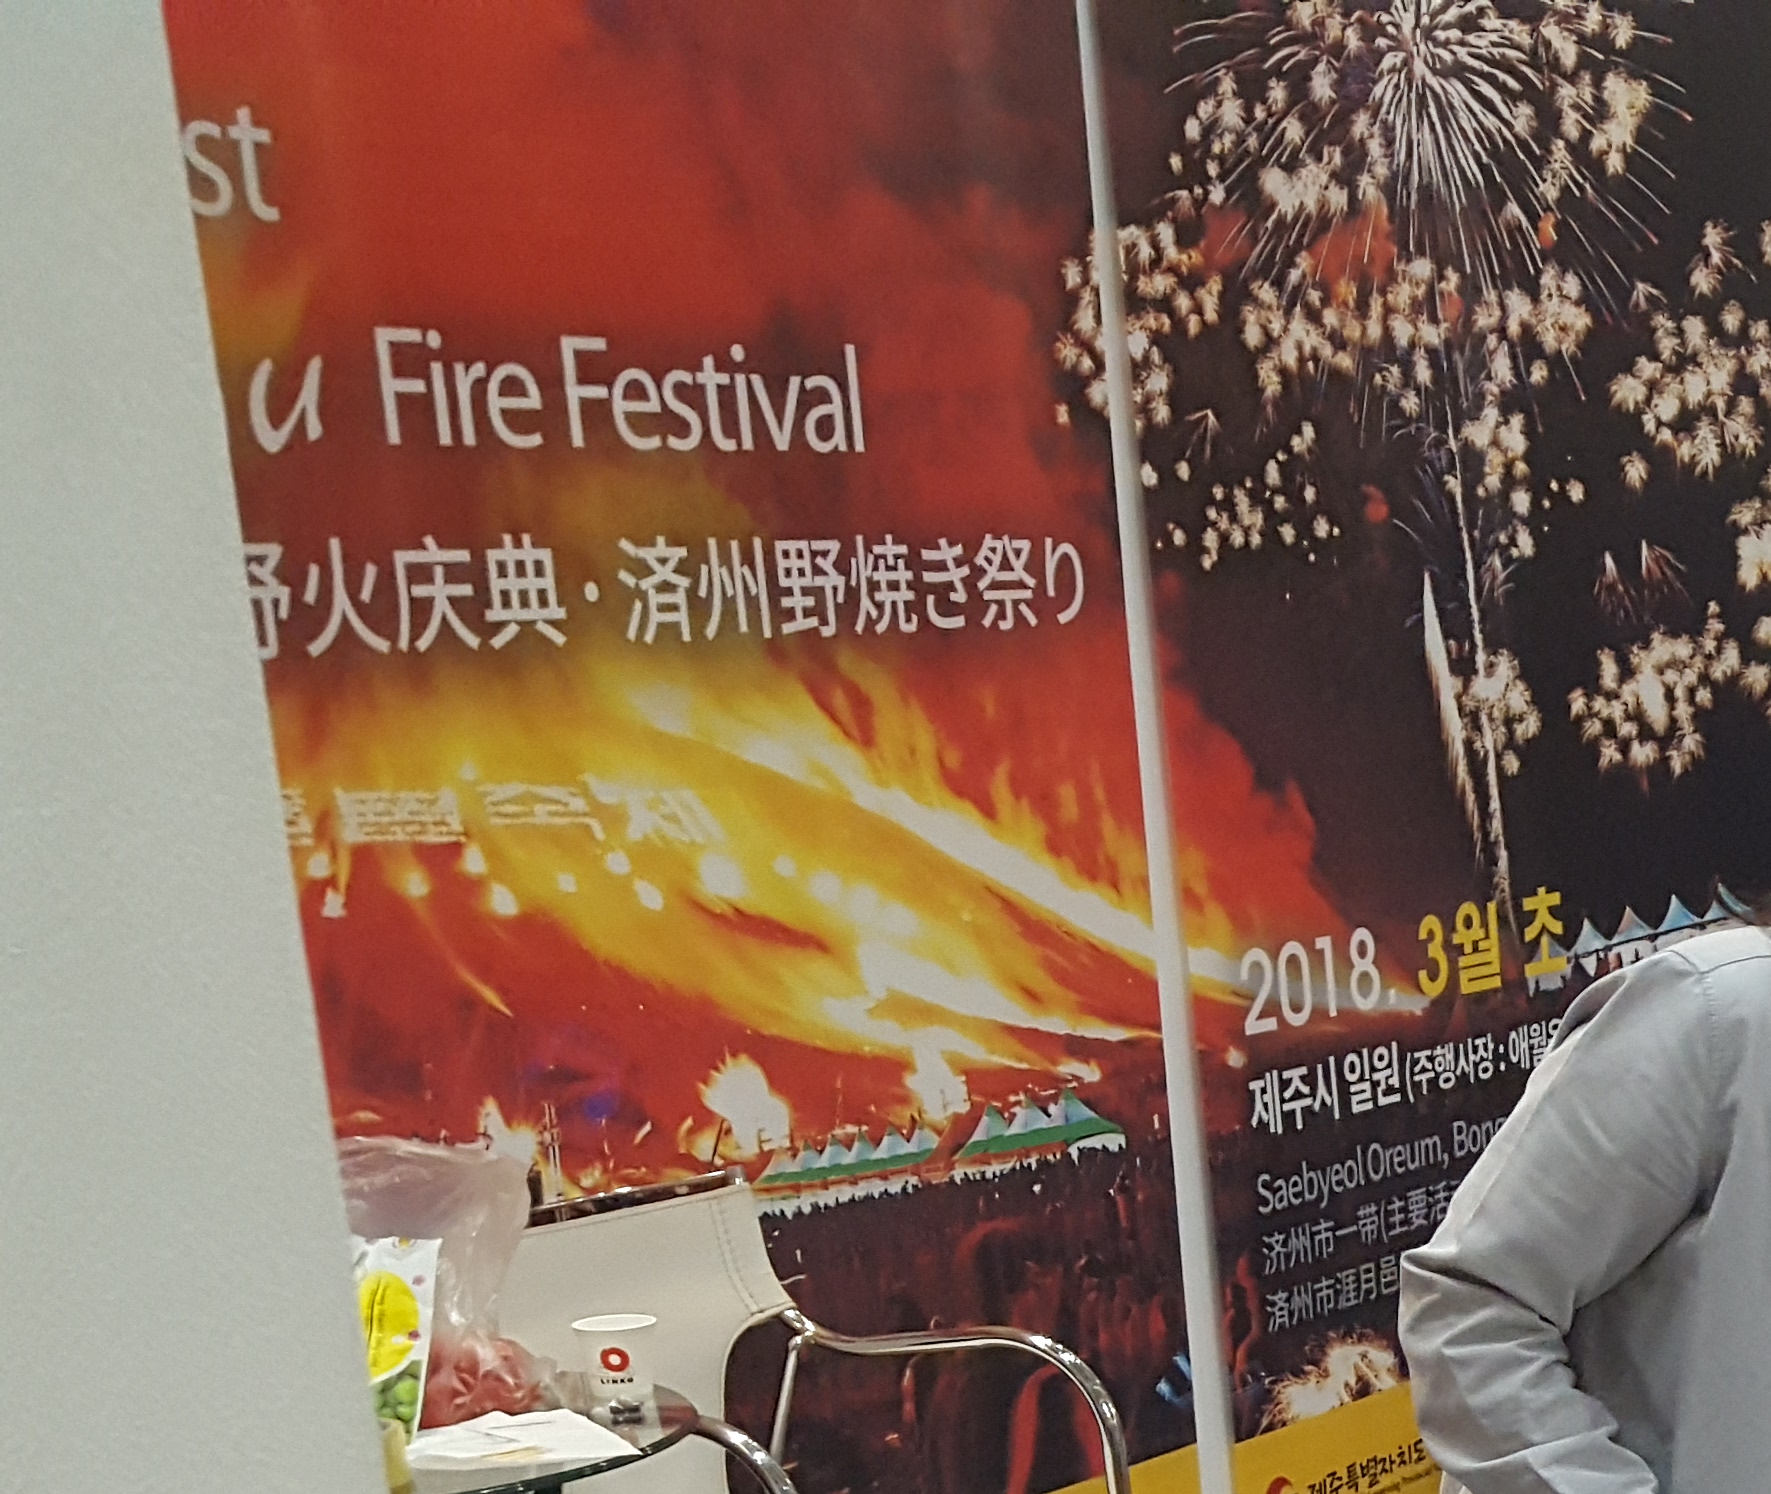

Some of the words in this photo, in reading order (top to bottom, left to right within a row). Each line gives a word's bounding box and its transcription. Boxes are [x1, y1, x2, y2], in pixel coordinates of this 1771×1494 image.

[373, 326, 543, 450] Fire
[560, 335, 867, 454] Festival
[1417, 899, 1503, 998] 3월
[1522, 885, 1569, 979] 초
[1247, 1056, 1341, 1135] 제주시
[1342, 1040, 1402, 1114] 일원
[1257, 1144, 1365, 1215] Saebyeol
[1367, 1134, 1451, 1182] Oreum,
